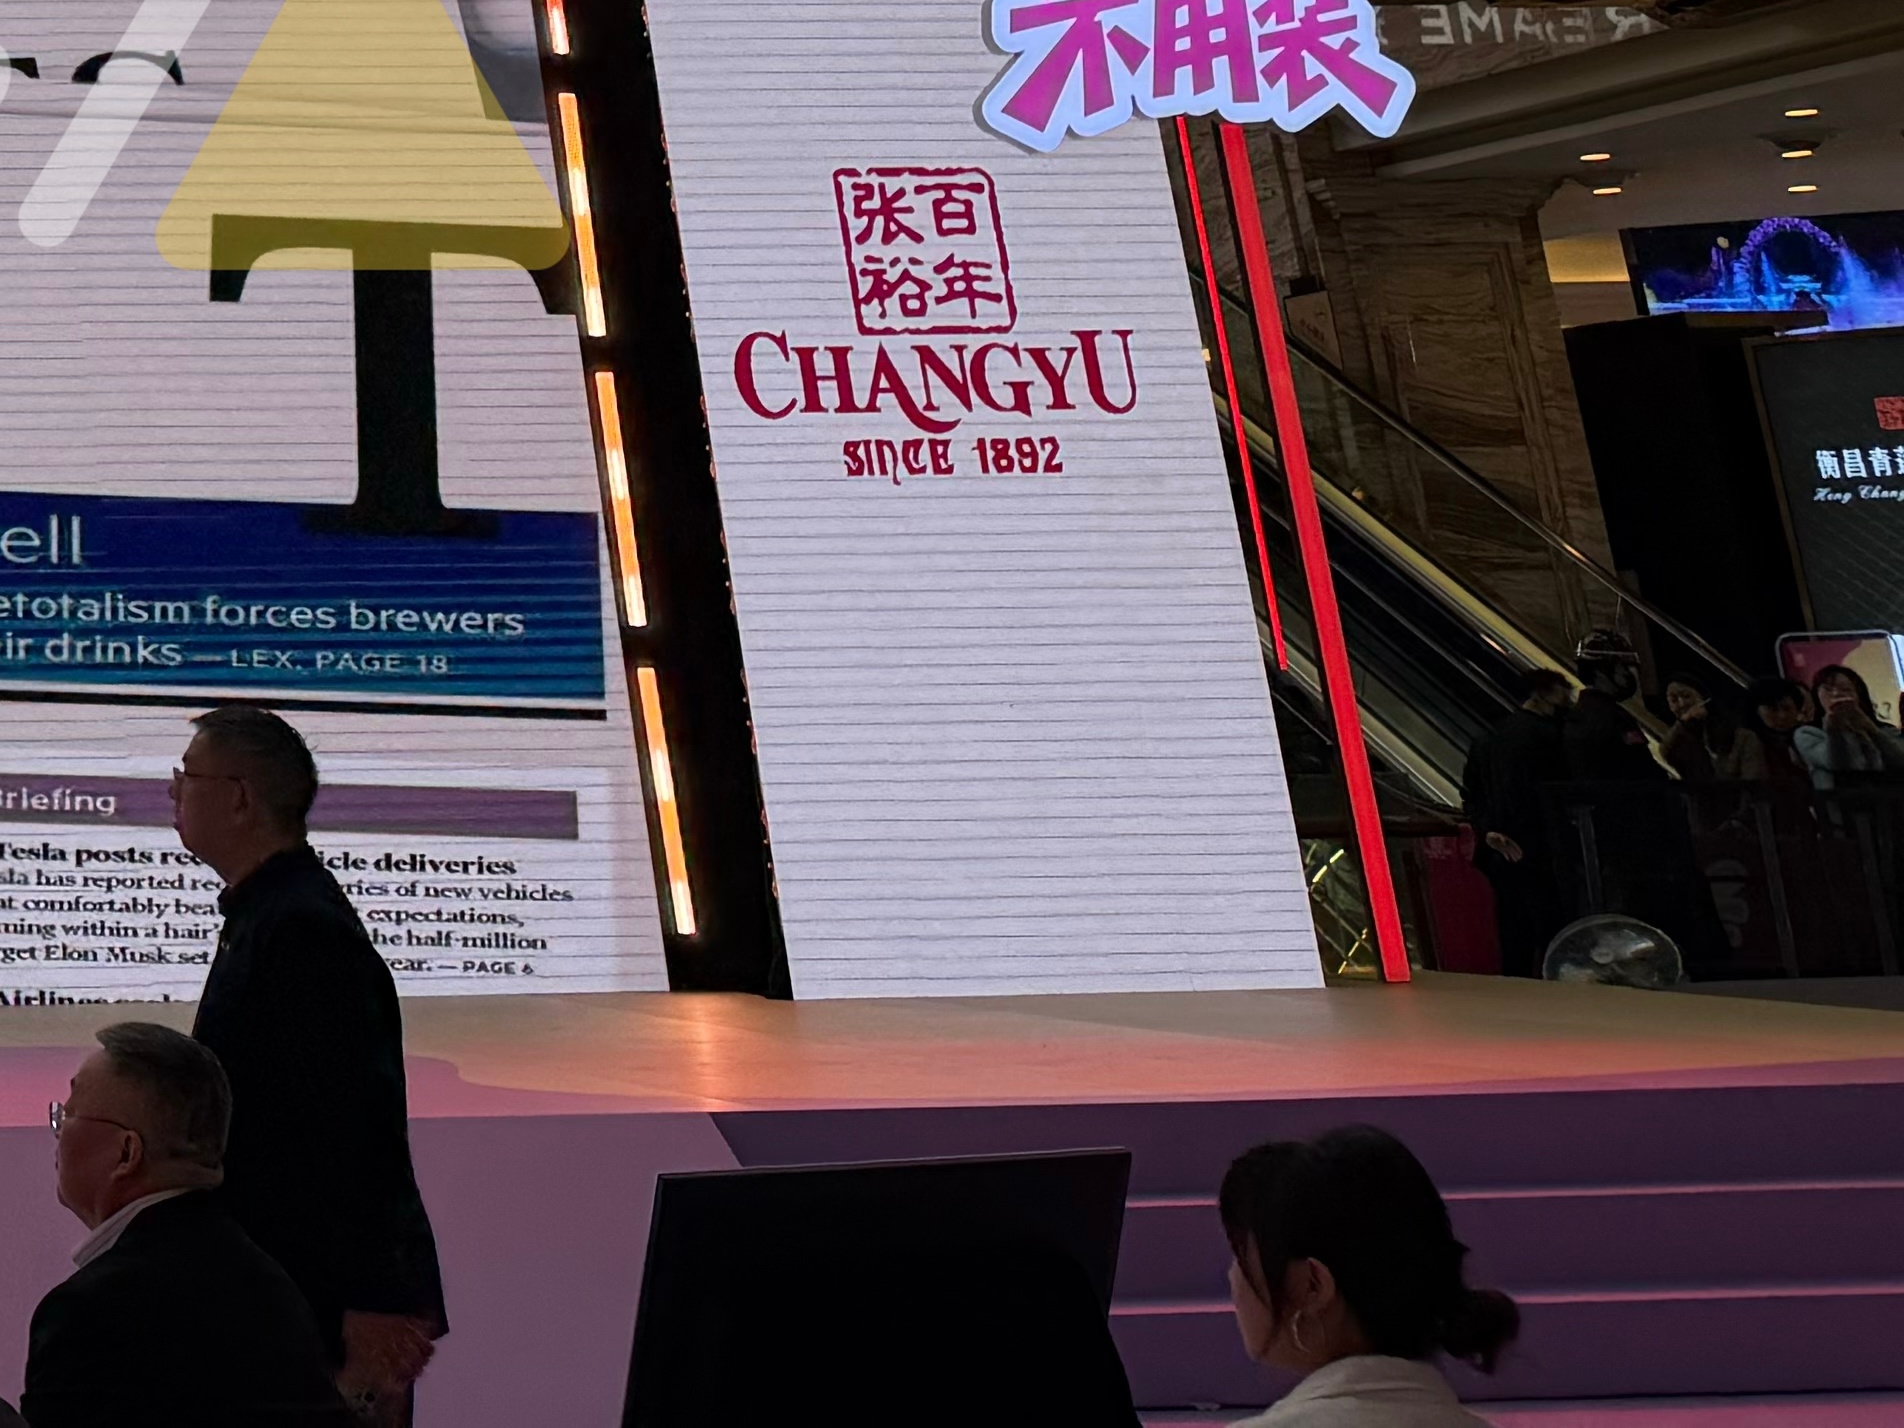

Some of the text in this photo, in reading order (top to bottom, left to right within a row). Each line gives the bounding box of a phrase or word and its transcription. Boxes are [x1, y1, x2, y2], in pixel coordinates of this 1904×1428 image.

[733, 328, 1138, 435] CHANGYU
[843, 436, 1064, 486] SINCE 1892
[203, 595, 337, 630] forces
[349, 600, 526, 637] brewers
[45, 632, 183, 667] drinks
[316, 651, 402, 672] PAGE
[415, 654, 449, 674] 18
[75, 847, 154, 868] posts
[373, 852, 517, 876] deliveries
[36, 869, 77, 887] has
[82, 873, 185, 893] reported
[394, 880, 421, 897] of
[424, 885, 473, 898] new
[478, 883, 575, 902] vehicles
[22, 896, 170, 919] comfortably
[366, 907, 525, 928] expectations,
[61, 919, 139, 938] within
[143, 925, 160, 938] a
[406, 928, 548, 950] half-million
[43, 943, 98, 964] Elon
[106, 944, 175, 965] Musk
[178, 950, 211, 966] set
[462, 960, 516, 975] PAGE
